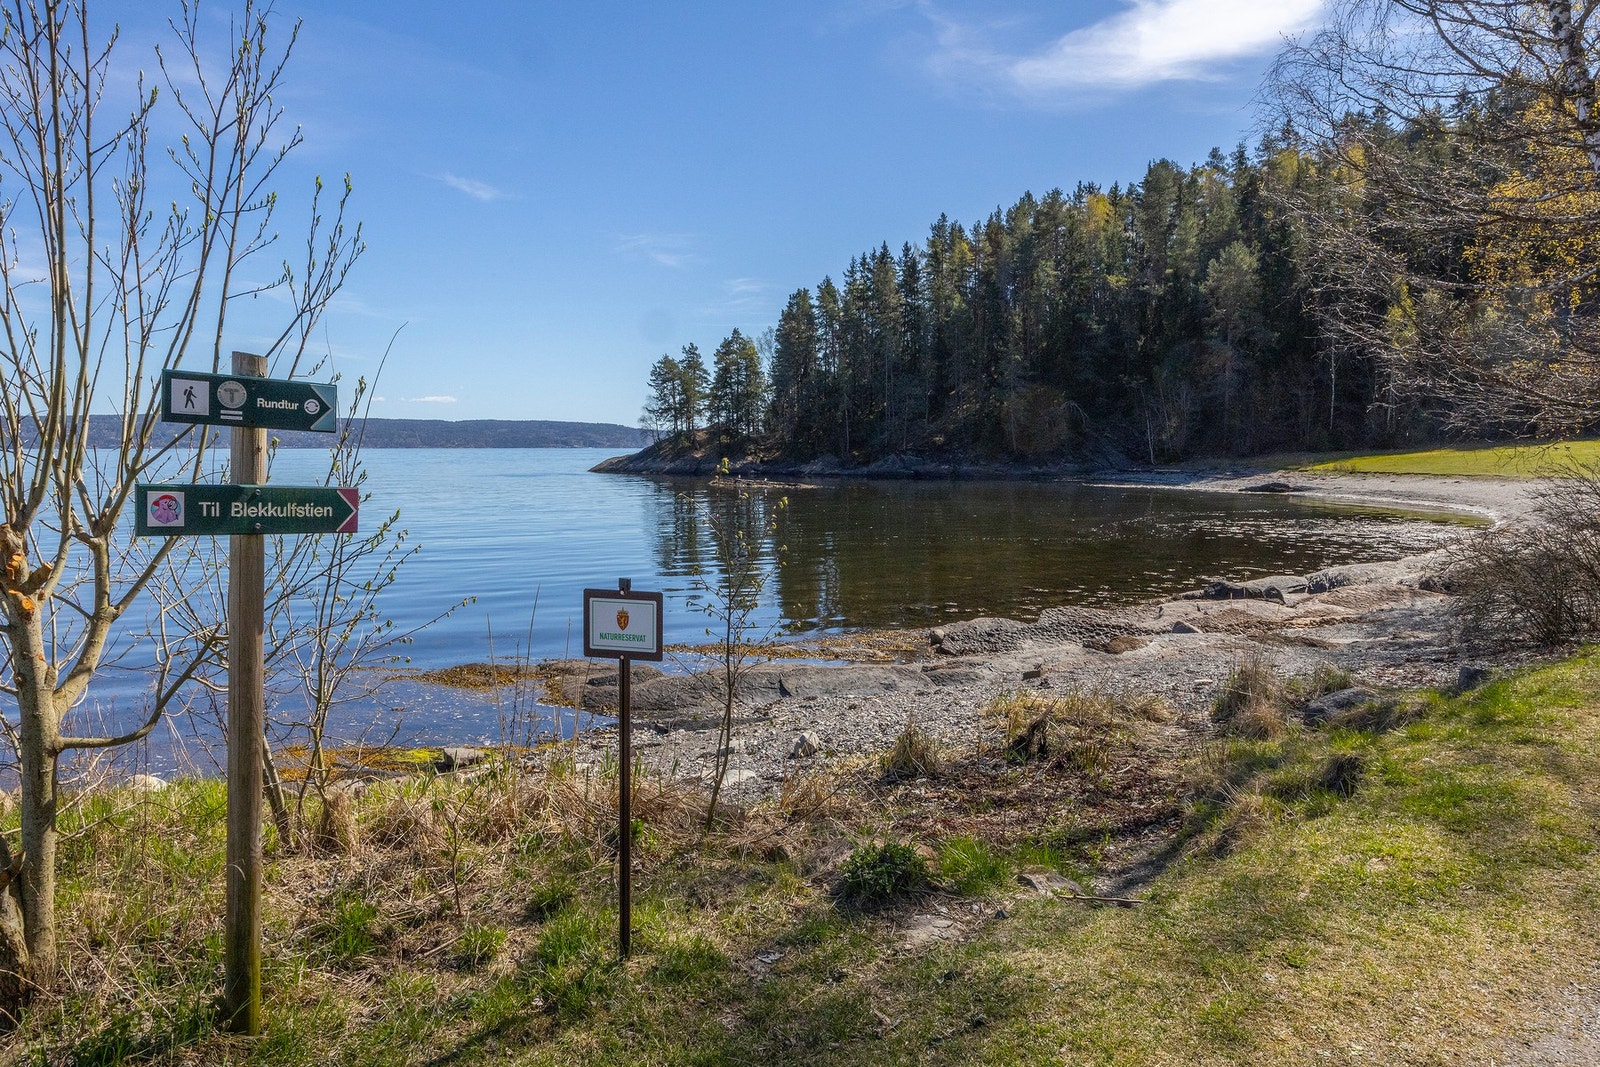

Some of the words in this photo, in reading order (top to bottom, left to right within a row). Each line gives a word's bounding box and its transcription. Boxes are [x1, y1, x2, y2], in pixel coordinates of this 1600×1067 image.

[257, 398, 299, 410] Rundtur
[199, 502, 219, 517] Til
[231, 502, 333, 517] Blekkulfstien
[600, 633, 646, 642] NATURRESERVAT
